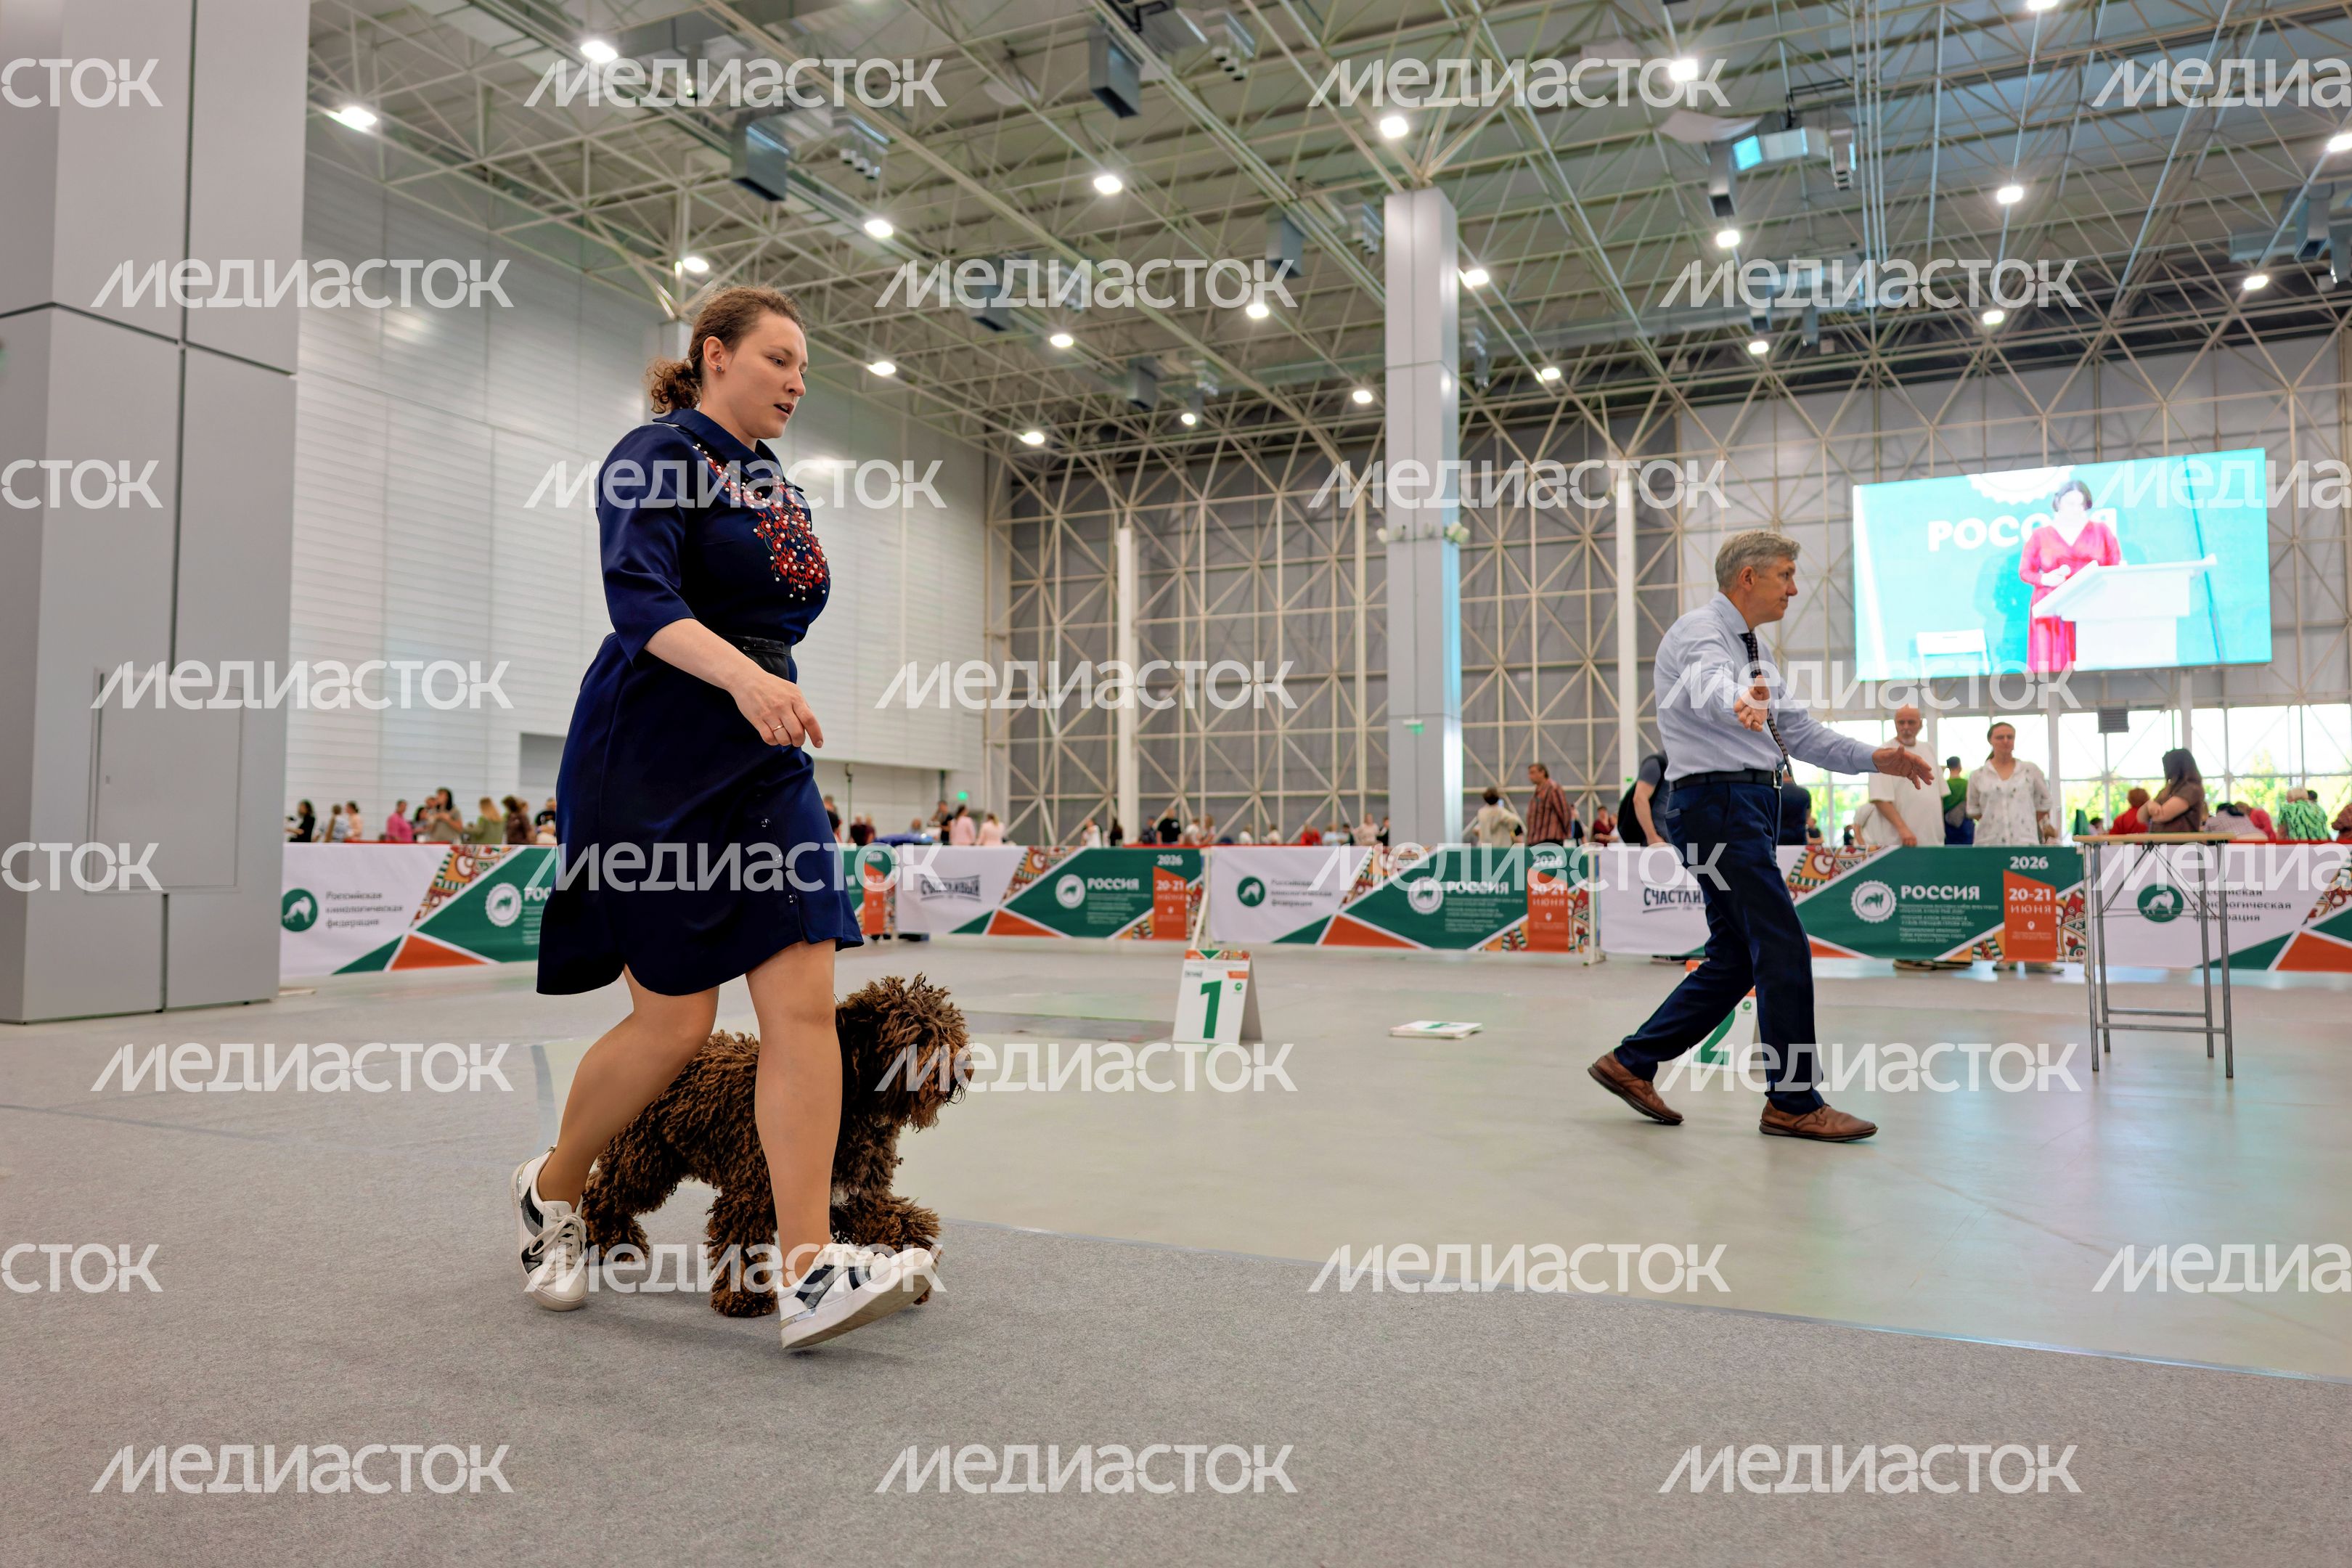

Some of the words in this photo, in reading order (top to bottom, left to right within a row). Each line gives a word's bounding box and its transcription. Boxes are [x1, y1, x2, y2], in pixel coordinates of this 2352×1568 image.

[1928, 508, 2116, 552] РОССЯ
[1532, 855, 1563, 867] 2026
[2009, 856, 2049, 870] 2026
[1087, 877, 1140, 891] РОССИЯ
[1447, 881, 1510, 895] РОССИЯ
[1644, 886, 1705, 906] СЧАСТЛИ
[1900, 885, 1981, 901] РОССИЯ
[2009, 888, 2051, 902] 20-21
[2010, 905, 2051, 914] ИЮНЯ
[1200, 981, 1222, 1039] 1
